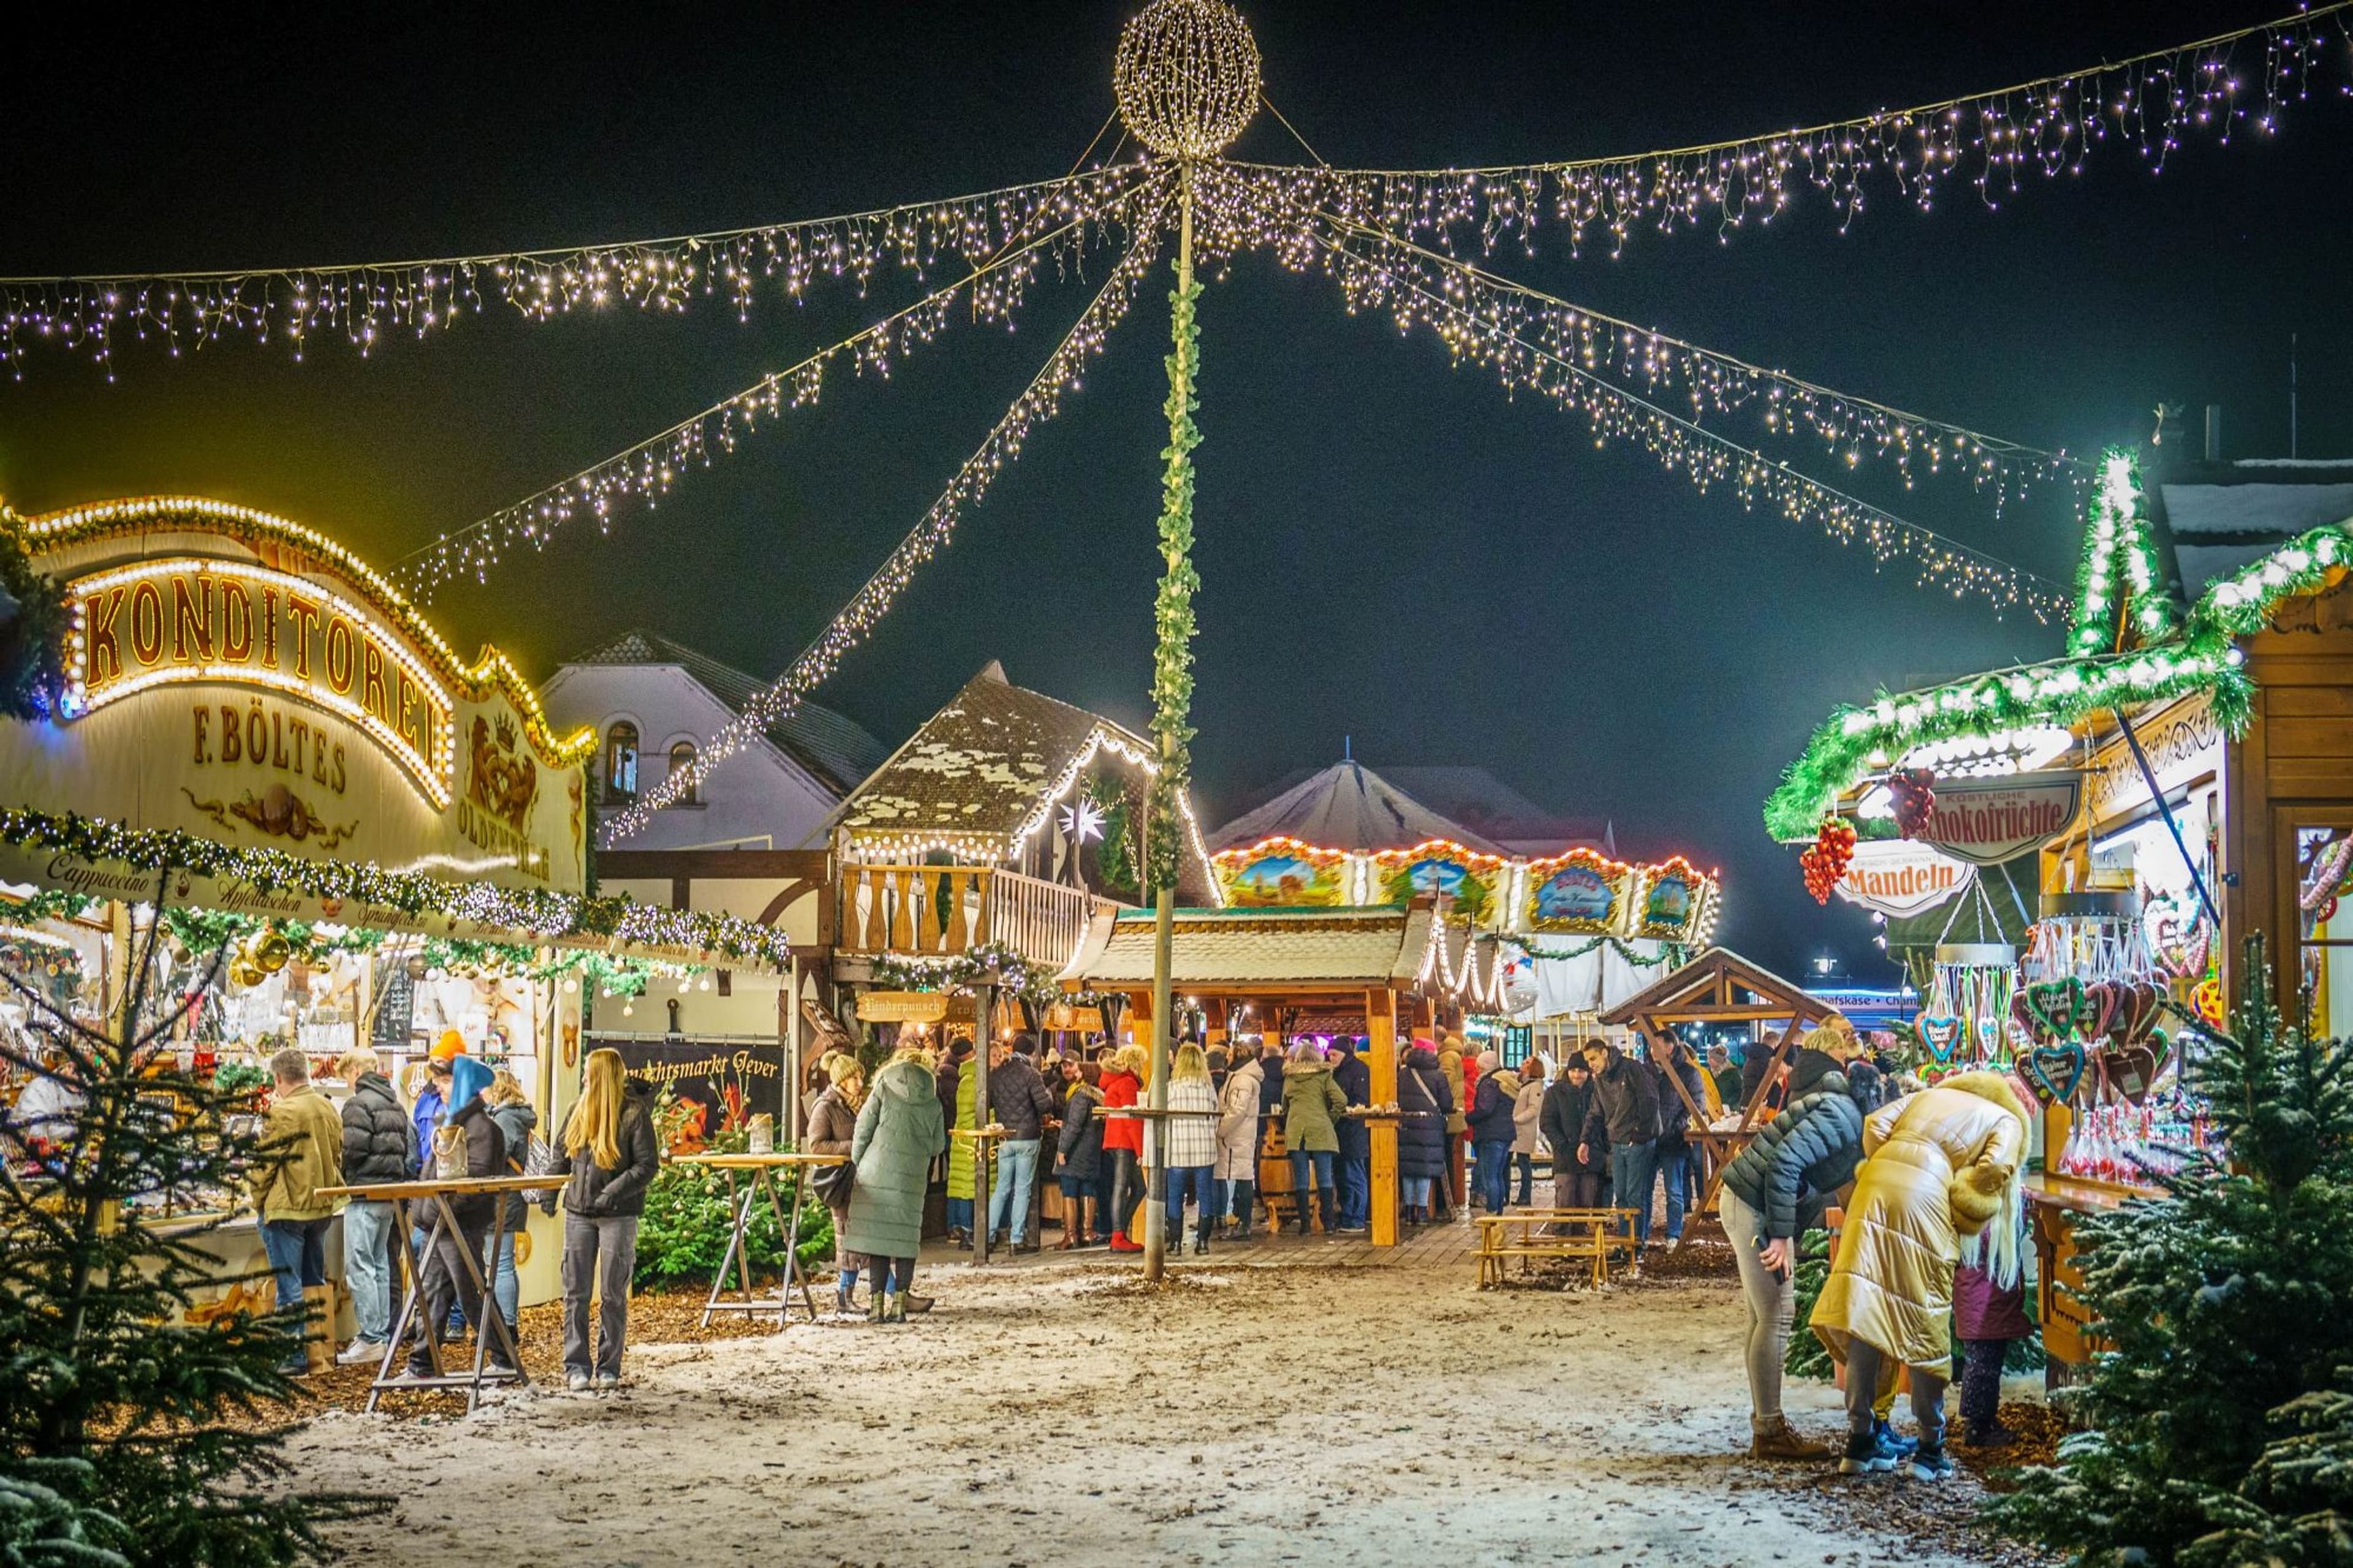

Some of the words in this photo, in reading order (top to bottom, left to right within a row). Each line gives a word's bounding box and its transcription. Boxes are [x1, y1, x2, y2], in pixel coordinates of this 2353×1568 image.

[85, 575, 439, 775] KONDITOREI
[1946, 790, 2026, 803] KÖSTLICHE
[1918, 798, 2063, 844] chokofrüchte
[47, 854, 150, 893] Cappuccino
[1847, 863, 1955, 896] Mandeln
[732, 1050, 778, 1079] Jever
